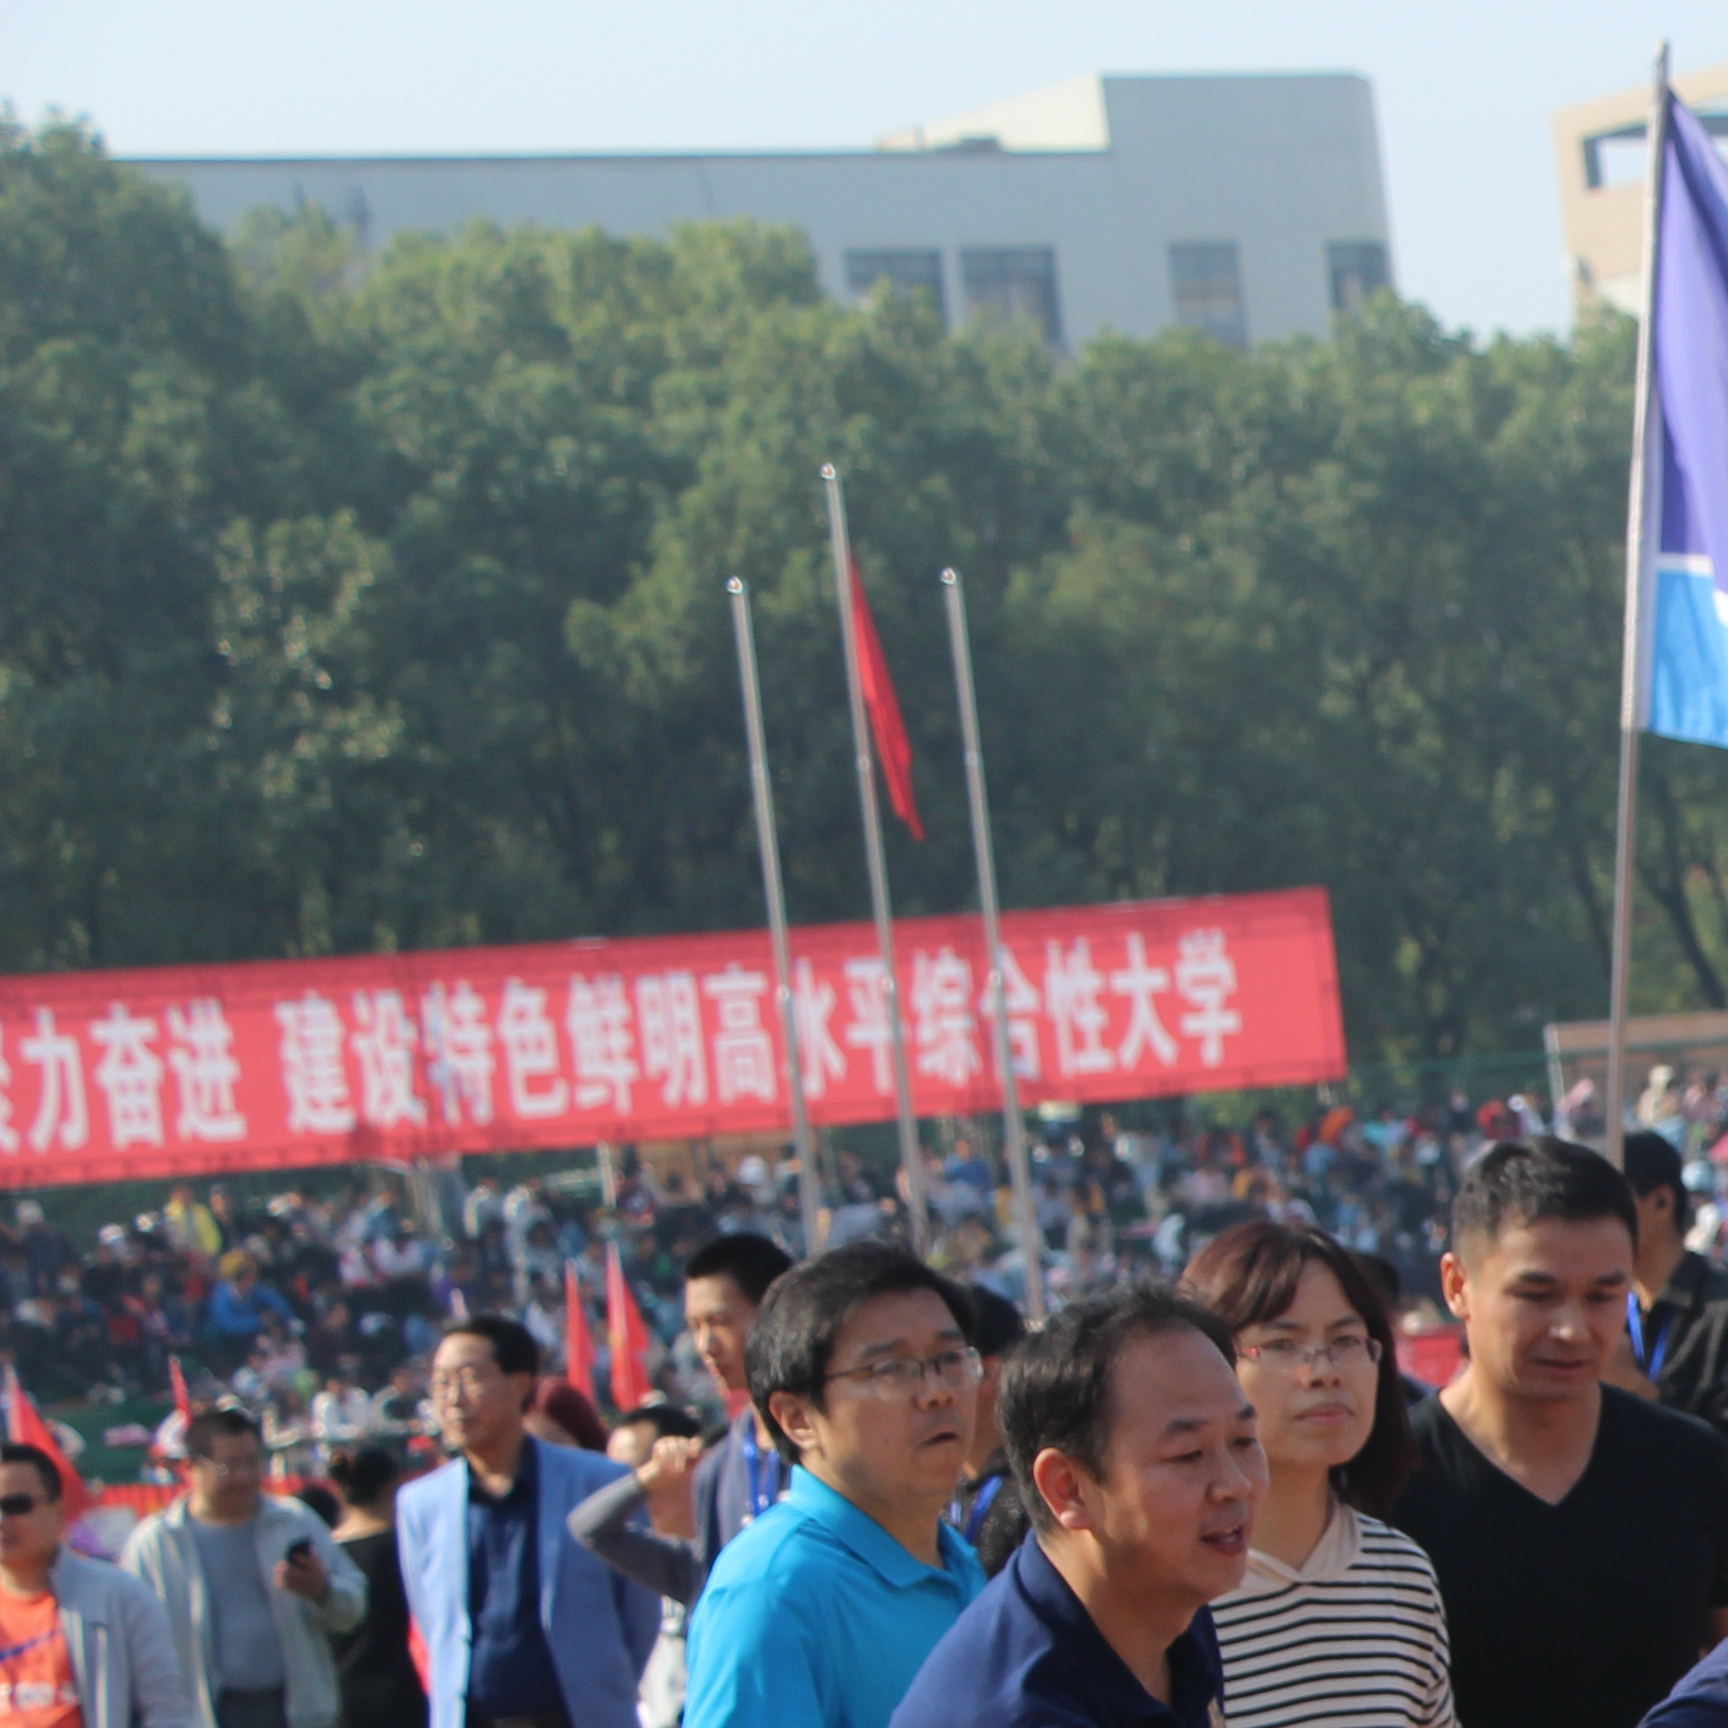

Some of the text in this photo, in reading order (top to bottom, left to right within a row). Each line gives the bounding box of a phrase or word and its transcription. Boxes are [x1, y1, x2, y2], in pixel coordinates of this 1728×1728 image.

[274, 927, 1242, 1133] 建设特色鲜明高水平综合性大学
